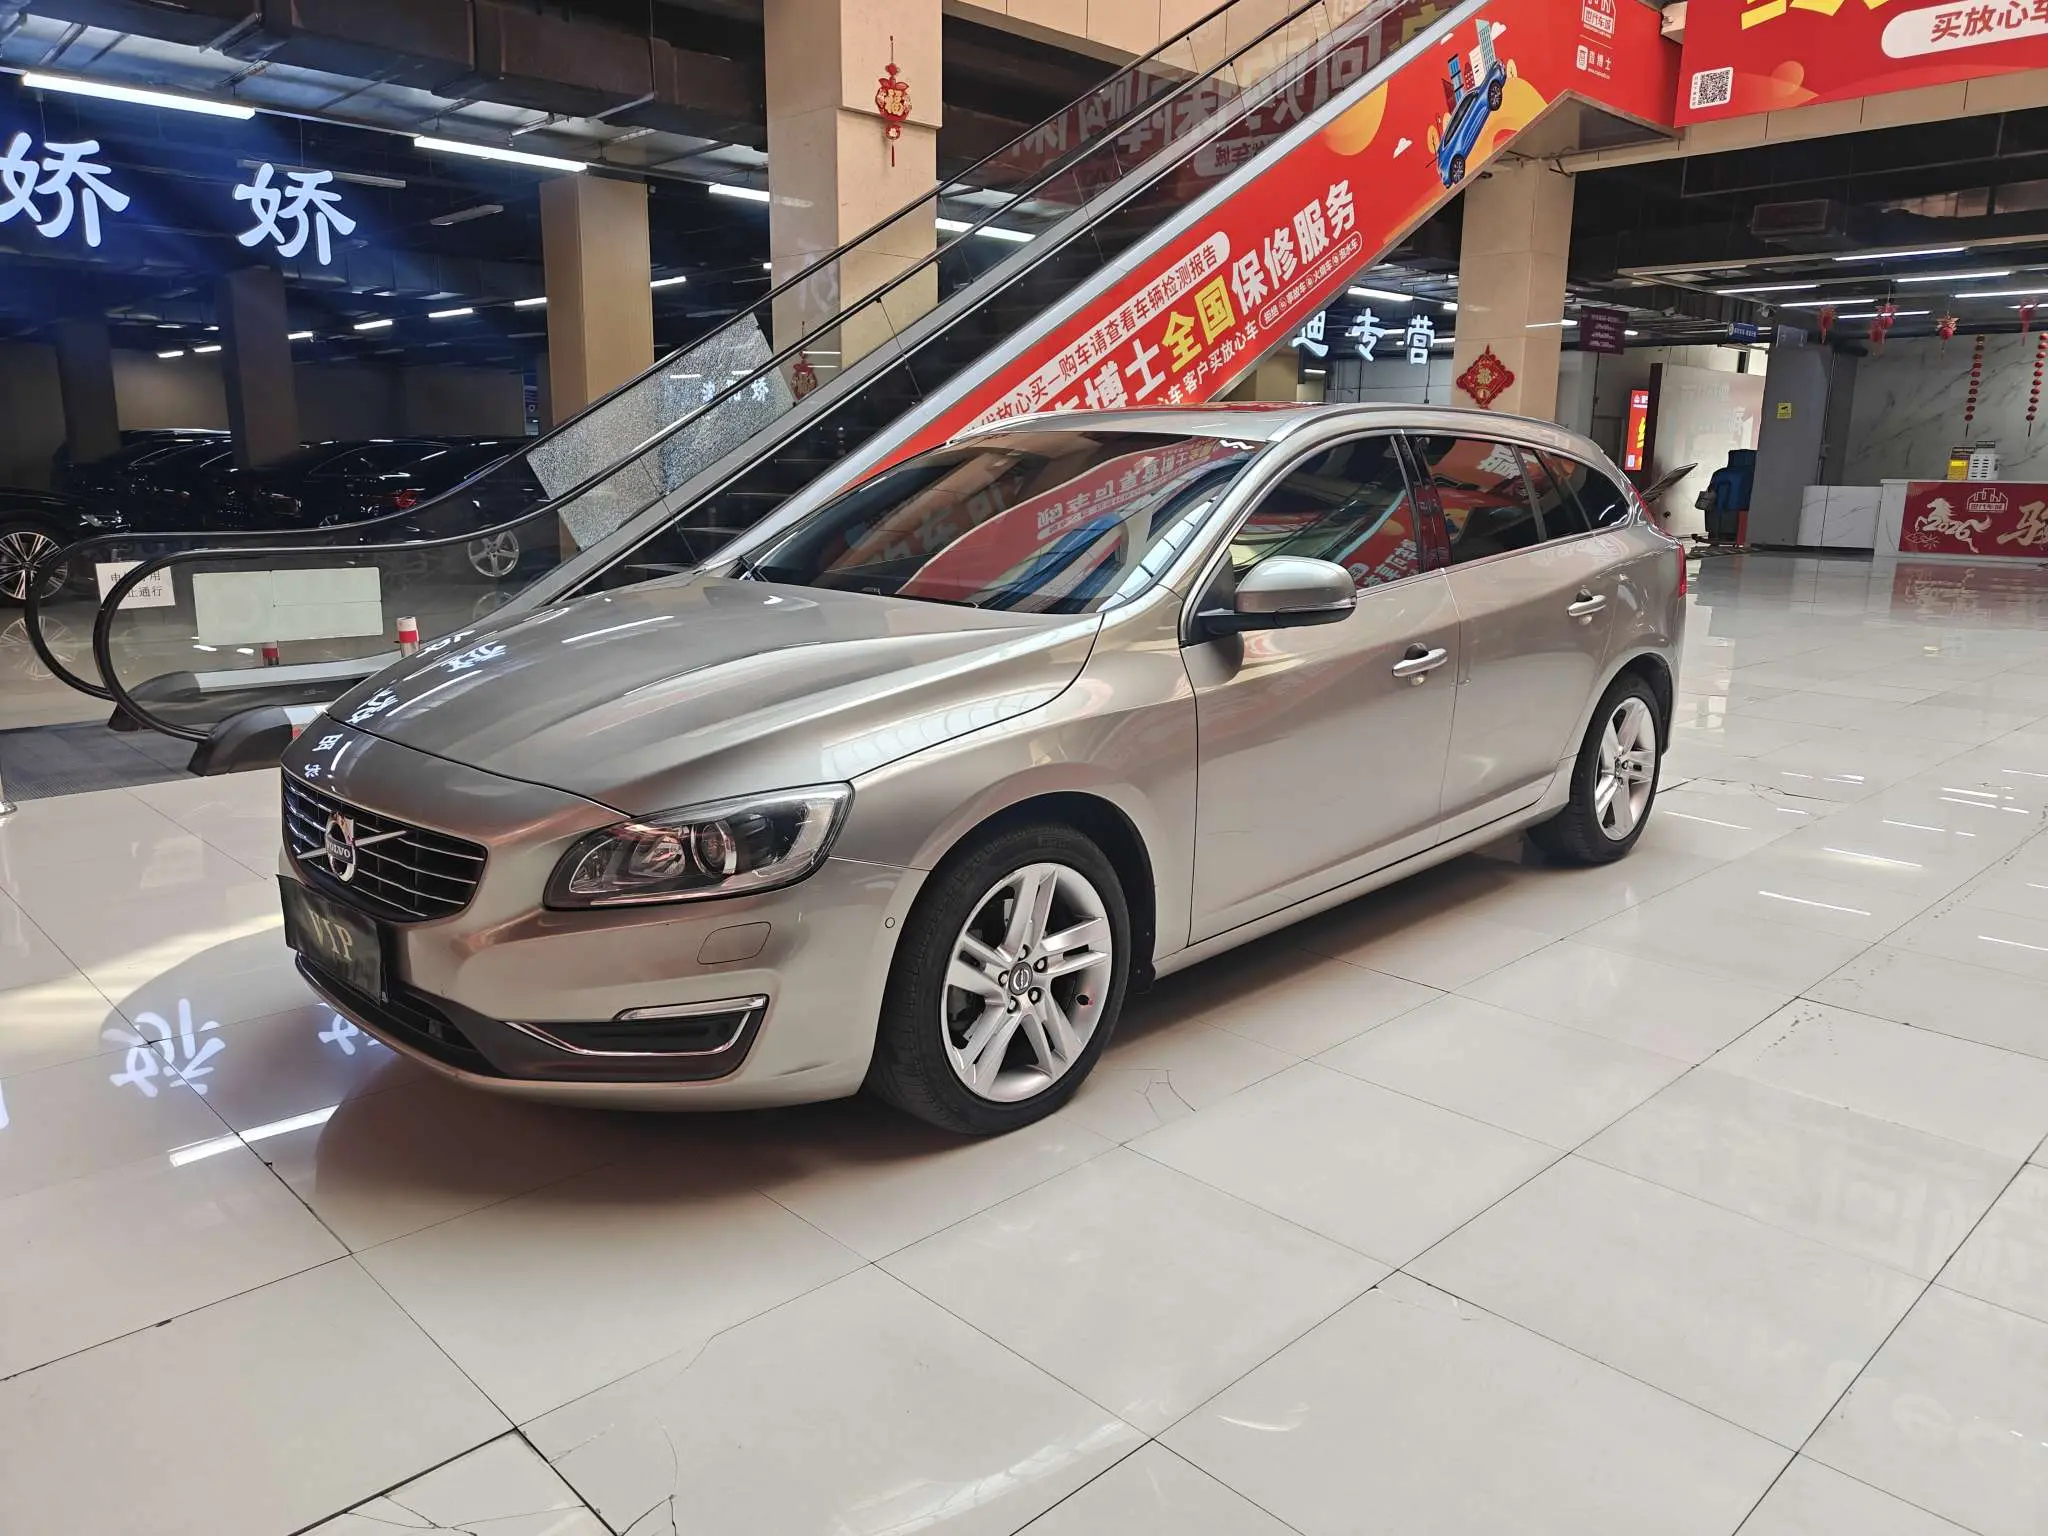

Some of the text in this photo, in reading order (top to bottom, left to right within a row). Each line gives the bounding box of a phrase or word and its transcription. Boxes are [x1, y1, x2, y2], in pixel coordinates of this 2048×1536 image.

[1923, 514, 1971, 541] 2026
[326, 841, 352, 859] VOLVO
[307, 905, 353, 963] VIP
